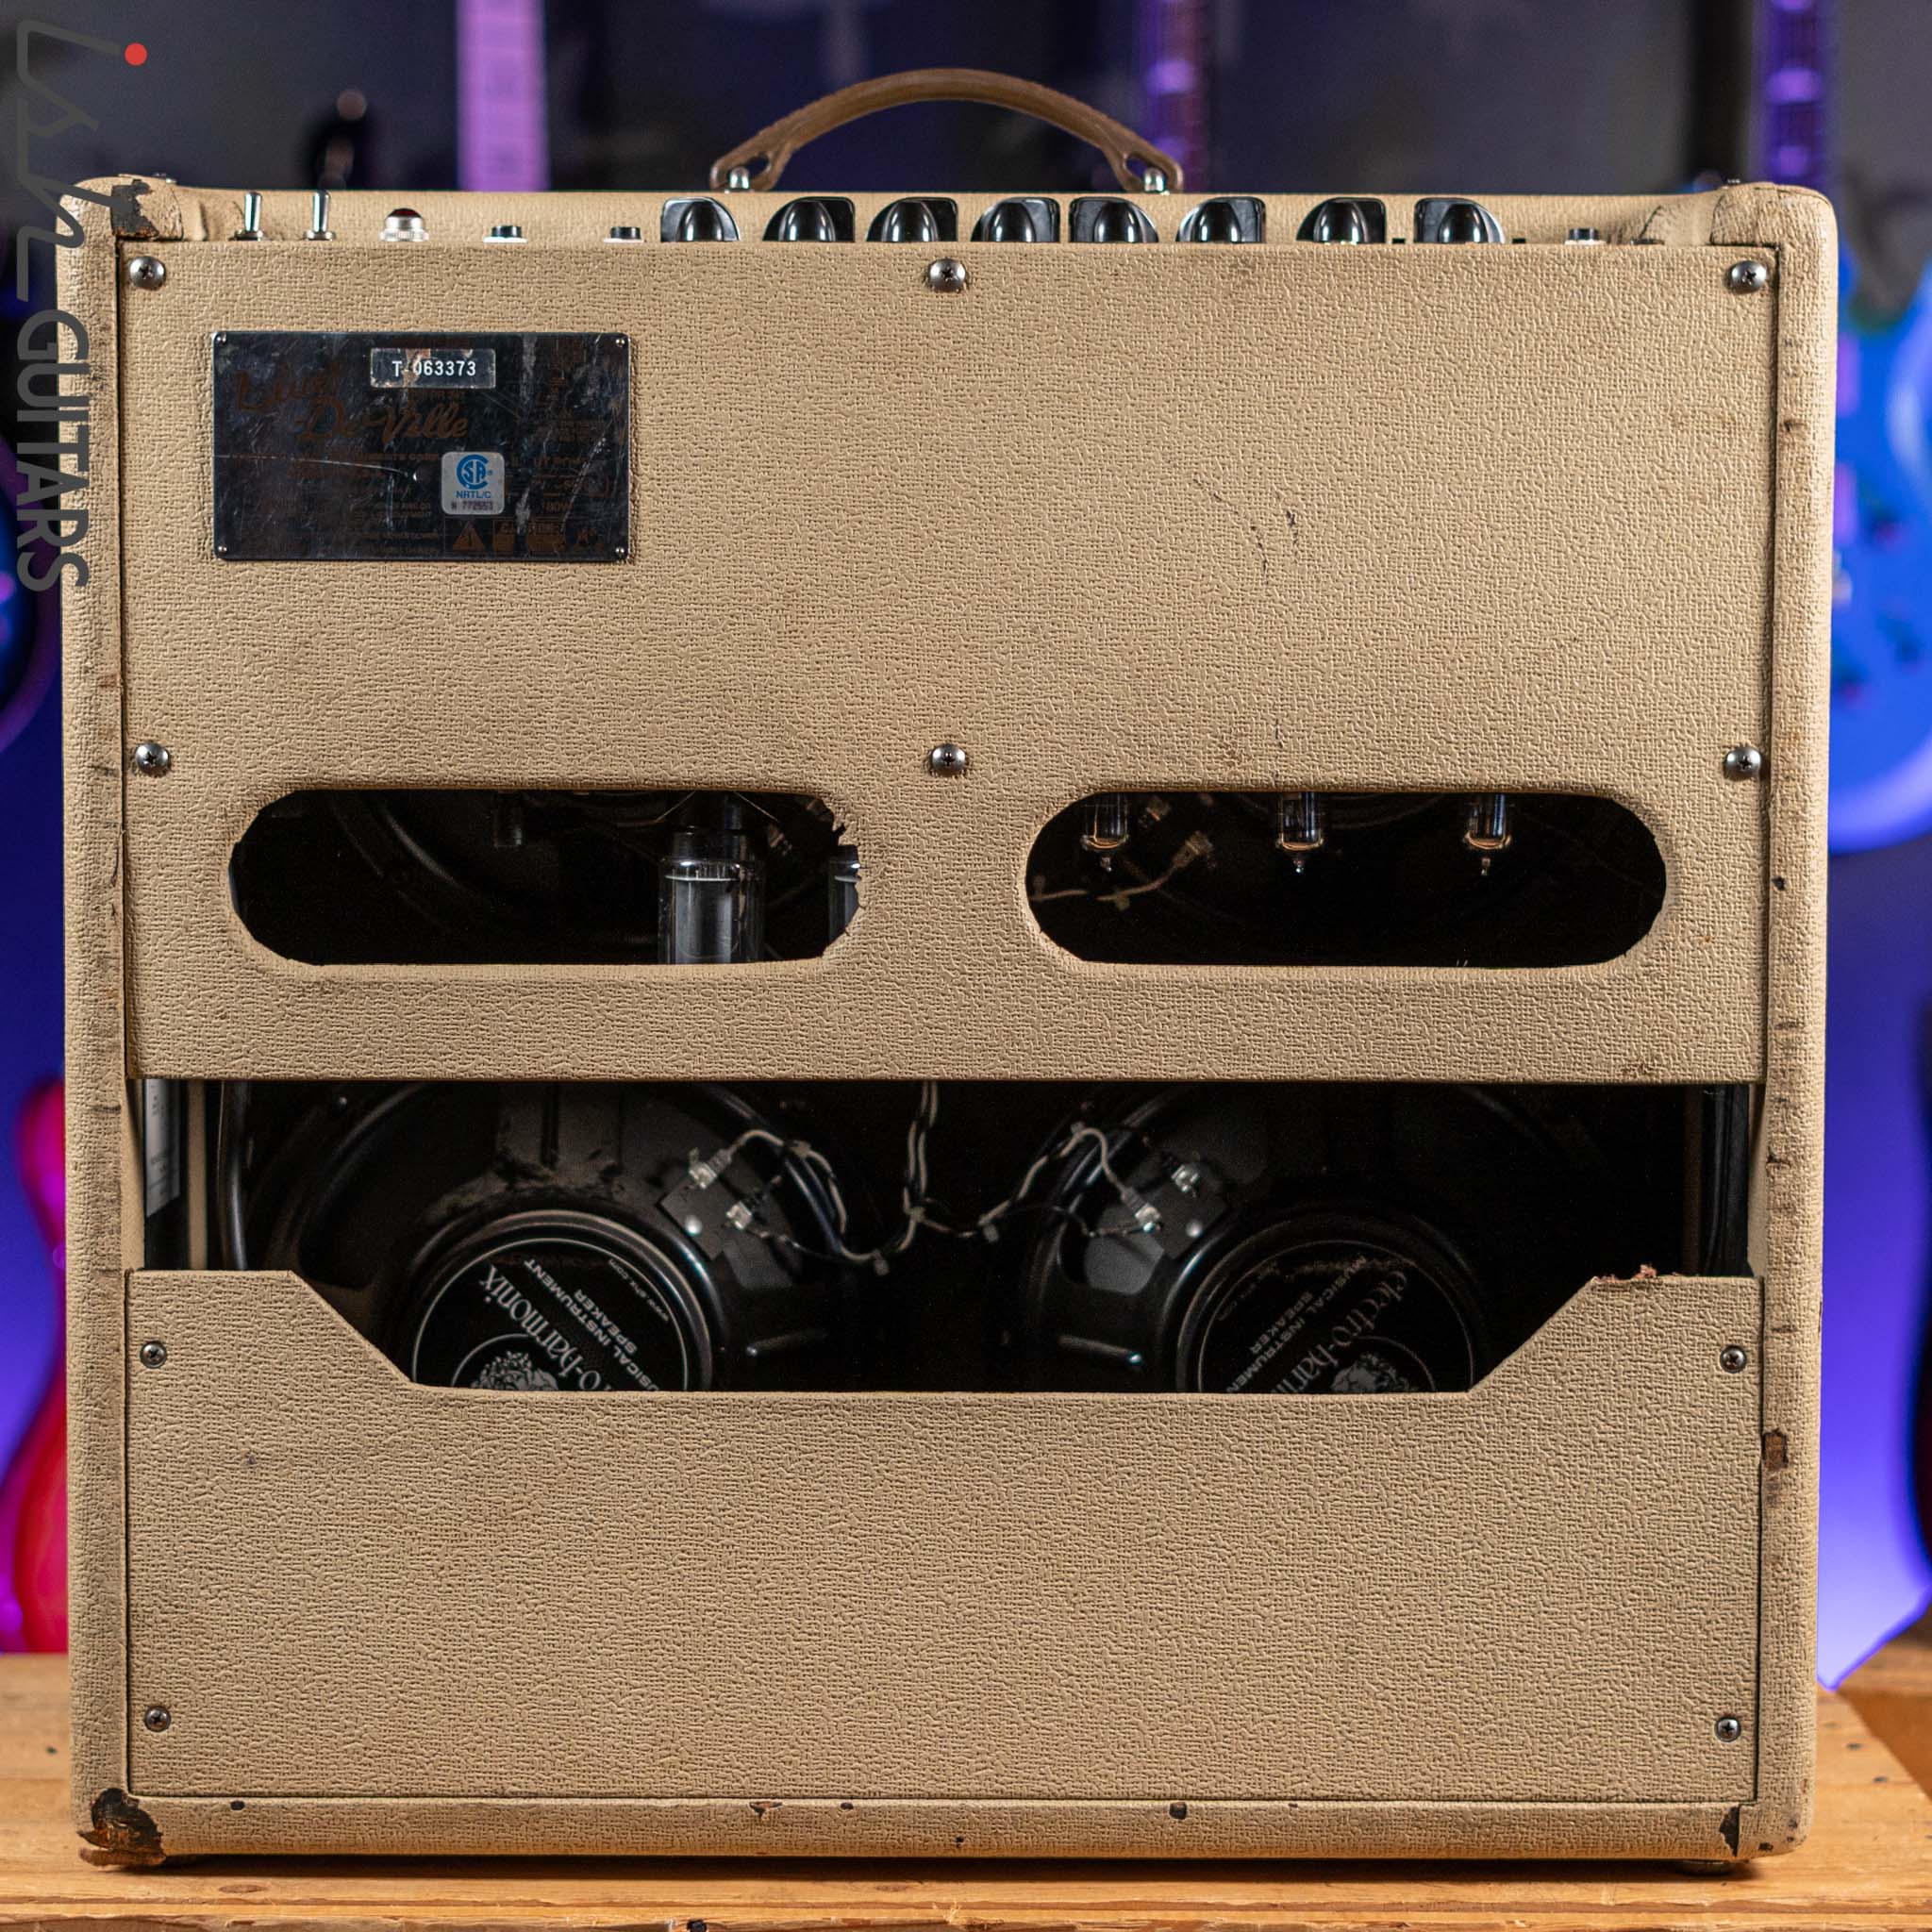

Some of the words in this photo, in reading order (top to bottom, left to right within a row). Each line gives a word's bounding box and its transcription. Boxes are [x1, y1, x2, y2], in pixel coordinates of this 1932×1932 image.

[524, 1257, 612, 1347] INSTRUMENT
[573, 1289, 638, 1356] SPEAKER
[608, 1257, 670, 1323] www.ehx.com
[1250, 1291, 1313, 1355] SPEAKER
[613, 1346, 660, 1391] USICAL
[1226, 1315, 1307, 1392] INSTRUMEN
